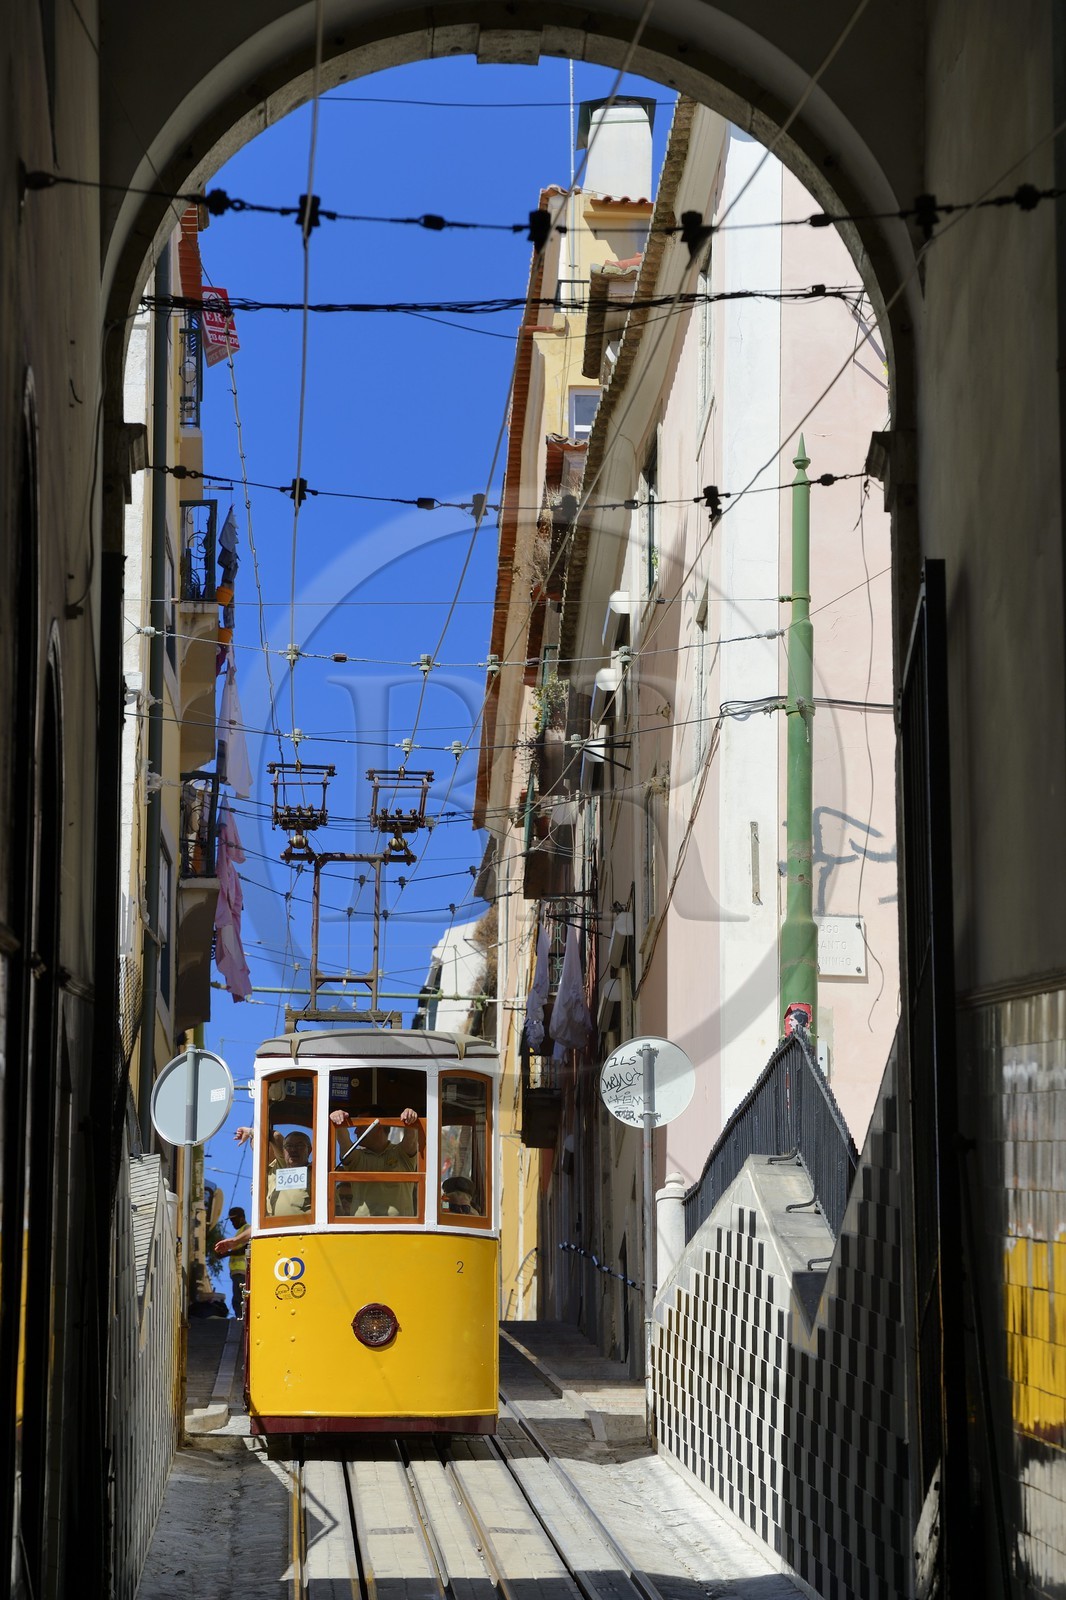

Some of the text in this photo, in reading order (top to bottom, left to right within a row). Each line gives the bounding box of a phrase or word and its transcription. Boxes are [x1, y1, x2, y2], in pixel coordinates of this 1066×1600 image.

[820, 924, 838, 933] RGO
[819, 940, 846, 950] ANTO
[278, 1173, 305, 1186] 3,60€
[456, 1260, 464, 1274] 2
